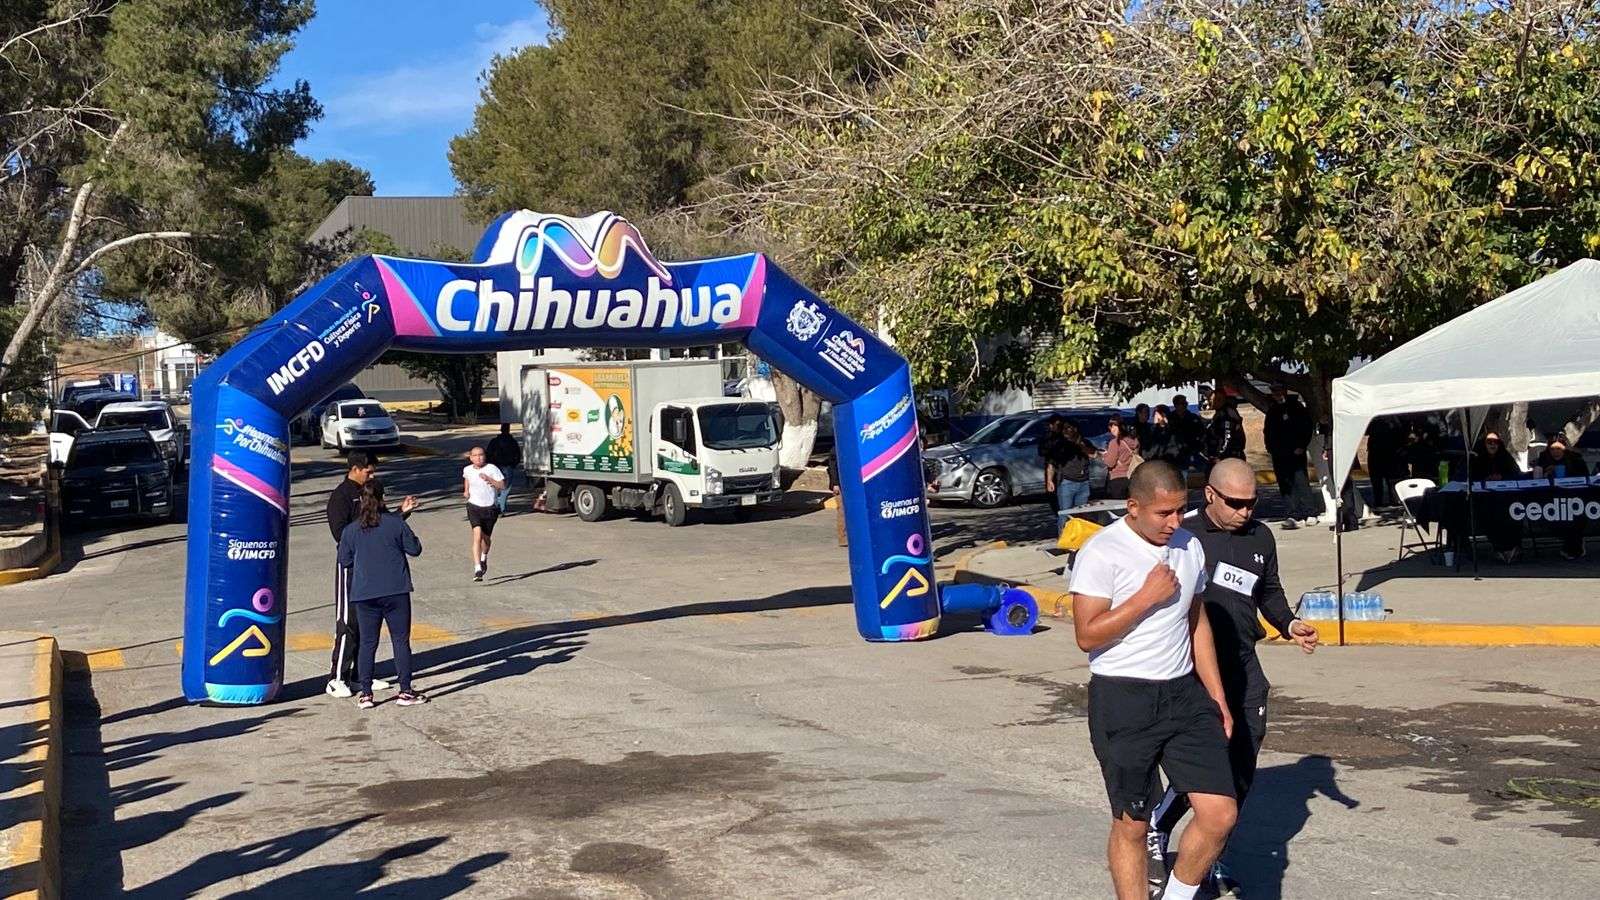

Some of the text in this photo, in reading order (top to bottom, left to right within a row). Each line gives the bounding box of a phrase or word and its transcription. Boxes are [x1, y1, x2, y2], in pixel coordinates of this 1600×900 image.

[436, 276, 743, 332] Chihuahua
[324, 325, 346, 344] Cultura
[337, 321, 361, 343] Deporte
[266, 340, 325, 396] IMCFD
[228, 538, 268, 550] Síguenos
[1223, 571, 1244, 586] 014
